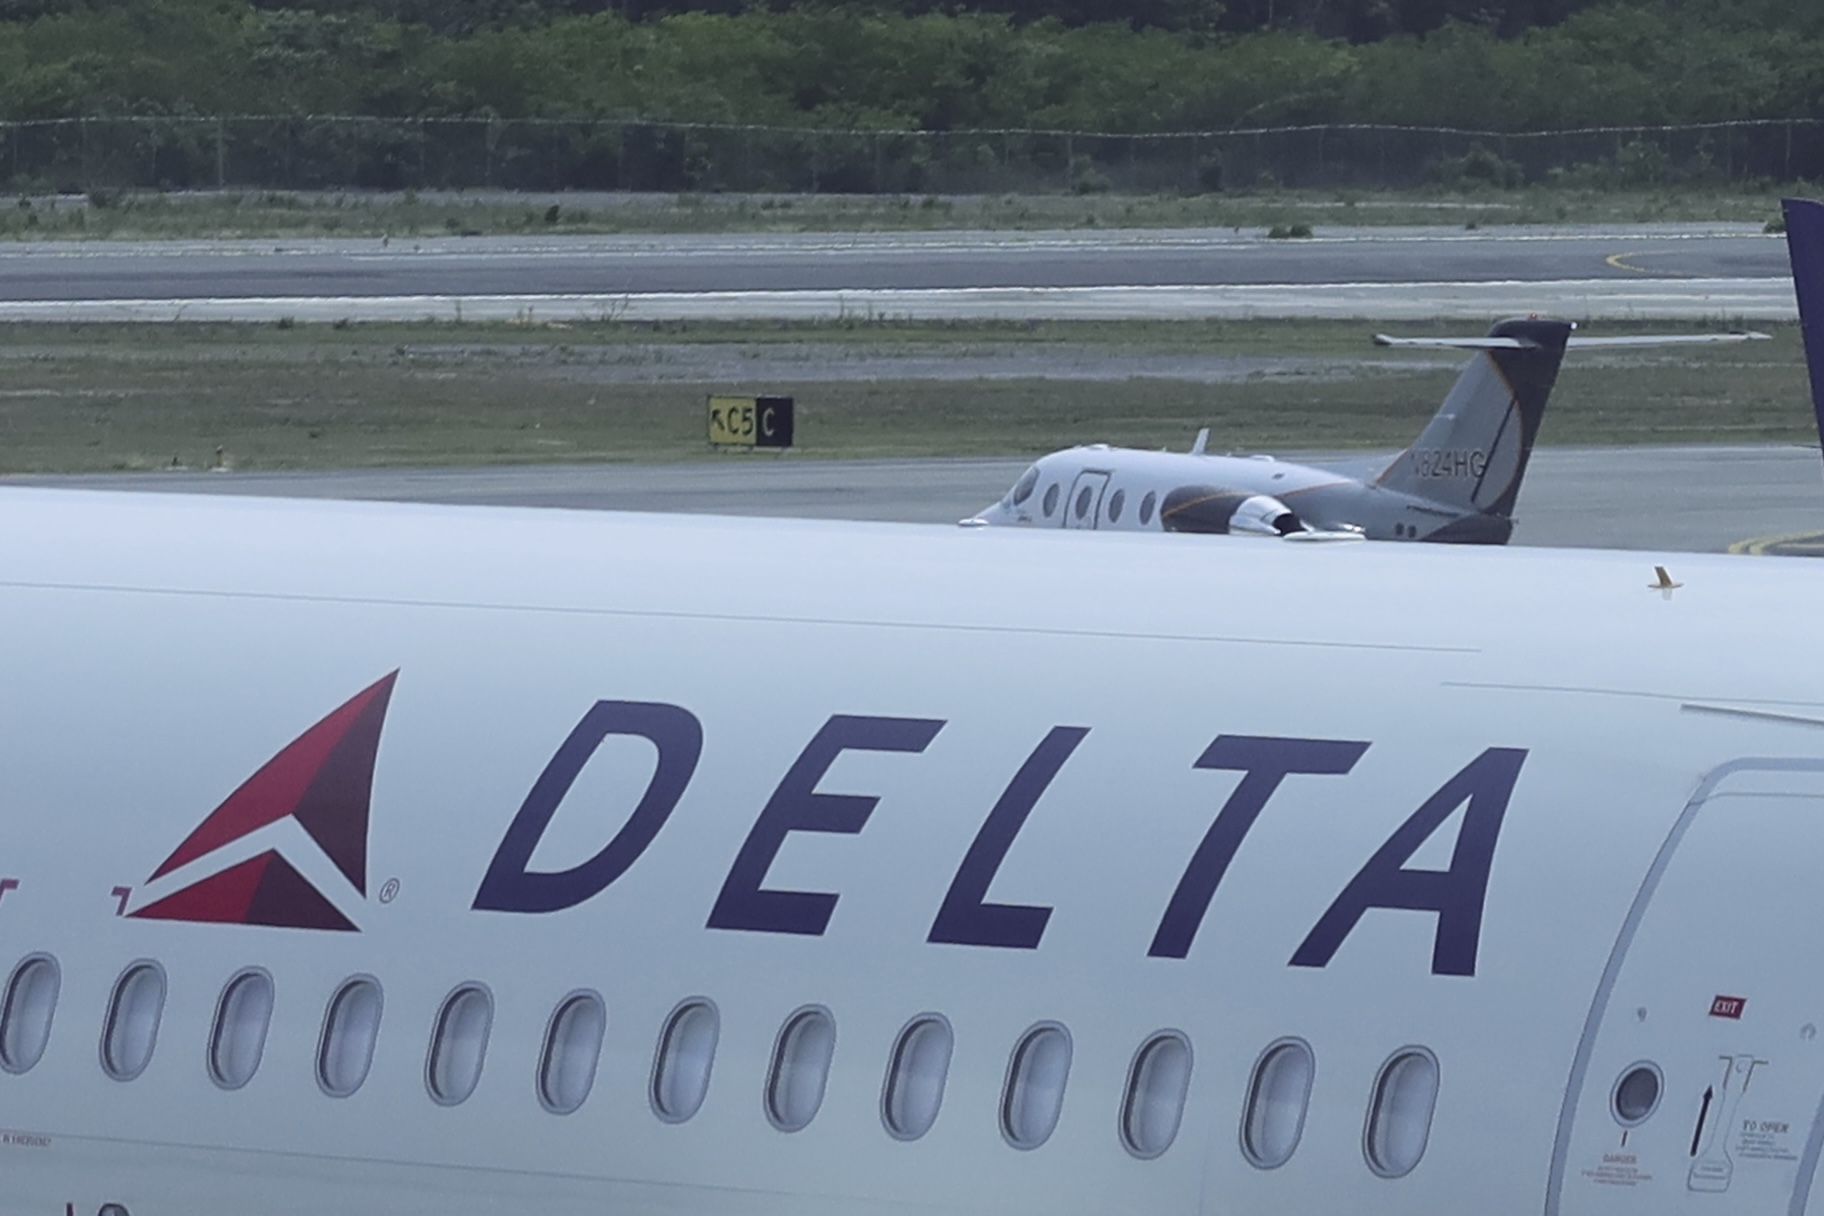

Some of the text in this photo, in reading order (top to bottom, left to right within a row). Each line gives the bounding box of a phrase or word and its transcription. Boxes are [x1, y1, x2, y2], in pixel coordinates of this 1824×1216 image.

[763, 408, 775, 436] C
[471, 699, 1530, 977] DELTA
[1713, 1000, 1740, 1014] EXIT
[1743, 1119, 1757, 1131] TO
